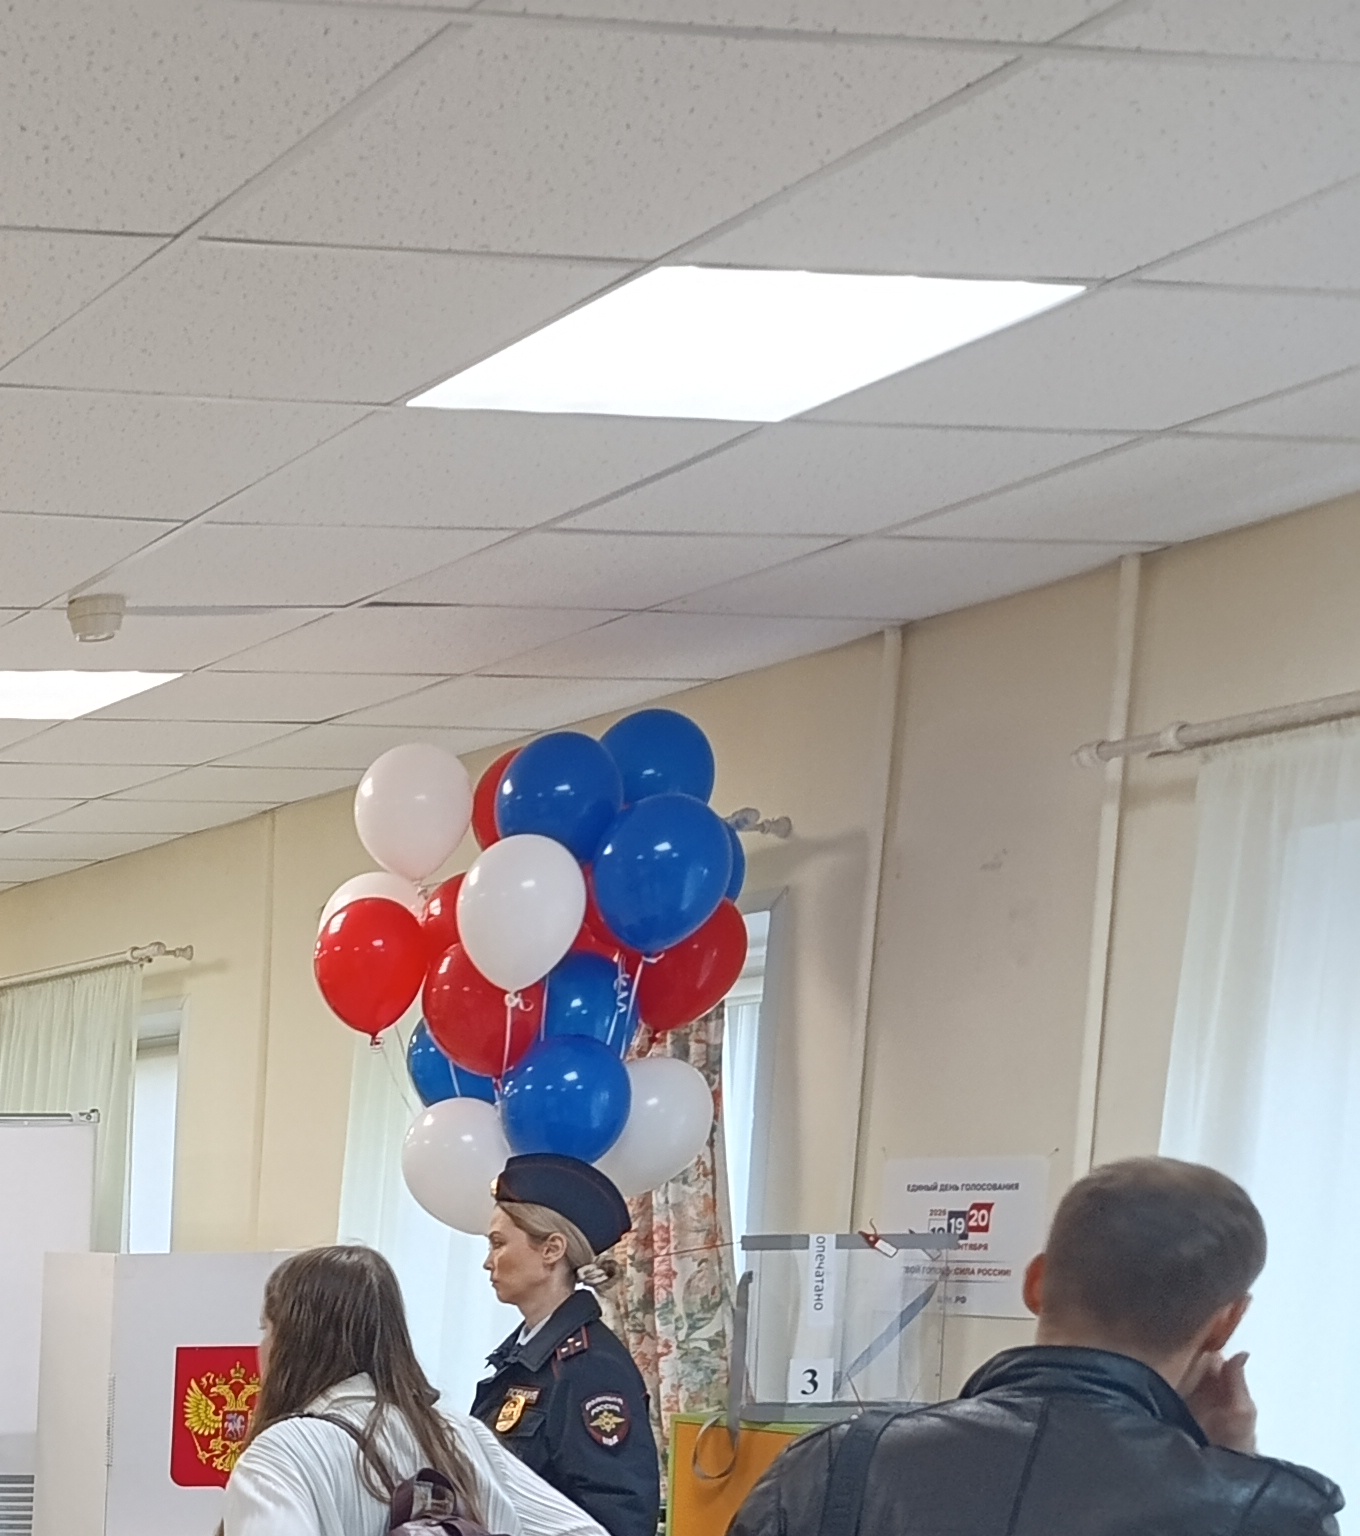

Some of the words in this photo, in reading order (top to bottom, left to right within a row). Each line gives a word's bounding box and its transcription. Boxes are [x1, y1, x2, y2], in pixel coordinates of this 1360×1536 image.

[906, 1181, 938, 1193] ЕДИНЫЙ
[939, 1183, 959, 1192] ДЕНЬ
[960, 1182, 1020, 1192] ГОЛОСОВАНИЯ
[949, 1217, 965, 1234] 19
[968, 1208, 989, 1227] 20
[813, 1235, 826, 1311] опечатано
[799, 1367, 819, 1396] 3
